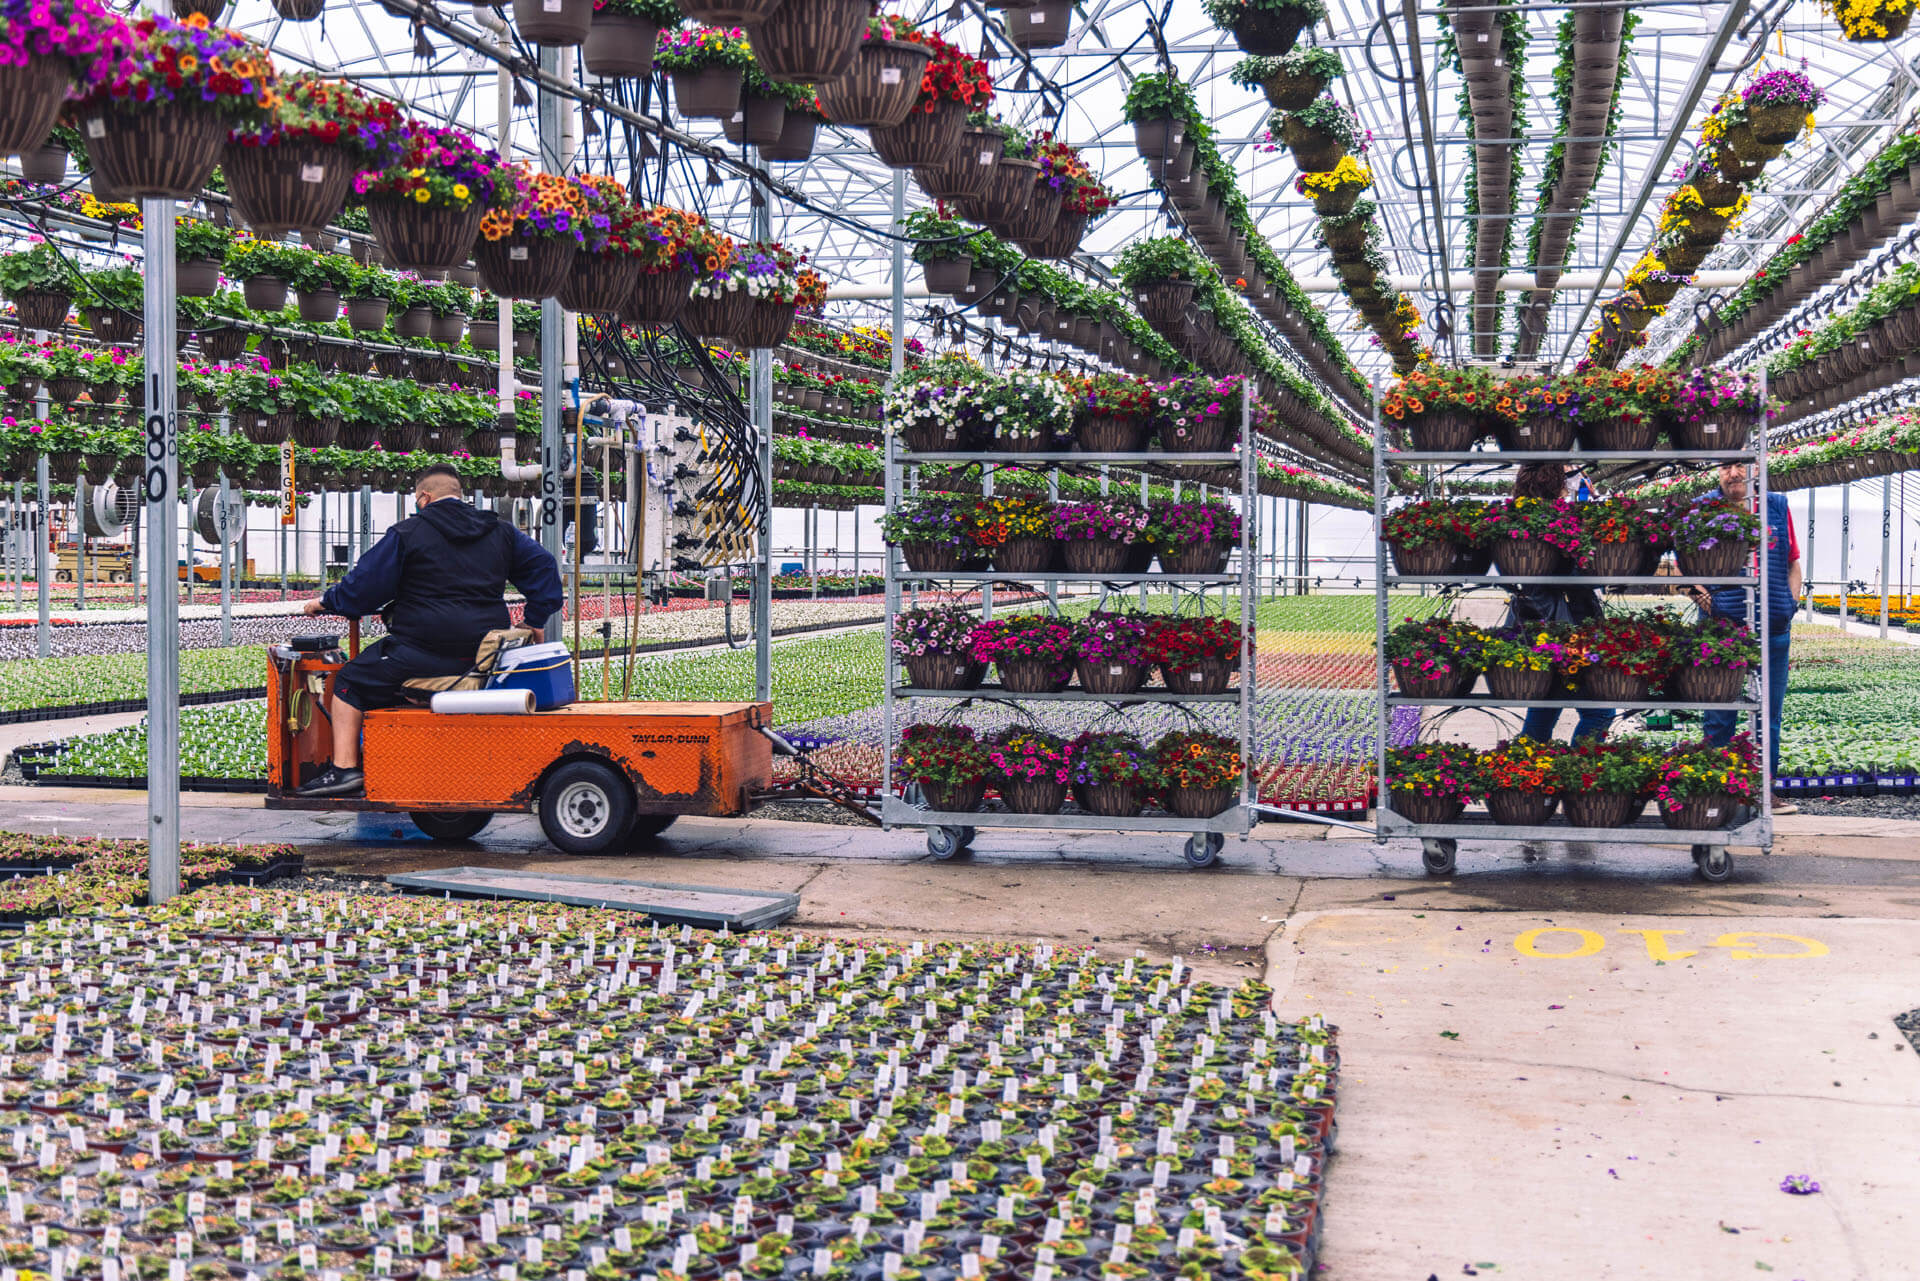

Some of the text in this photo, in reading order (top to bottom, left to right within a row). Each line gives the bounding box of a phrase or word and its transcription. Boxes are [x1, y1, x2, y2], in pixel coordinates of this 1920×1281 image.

[147, 373, 167, 502] 180
[167, 392, 176, 456] 180
[543, 447, 557, 526] 168
[1808, 519, 1815, 539] 72
[1842, 515, 1849, 535] 84
[1883, 509, 1890, 538] 96
[632, 734, 710, 744] TAYLOR-DUNN
